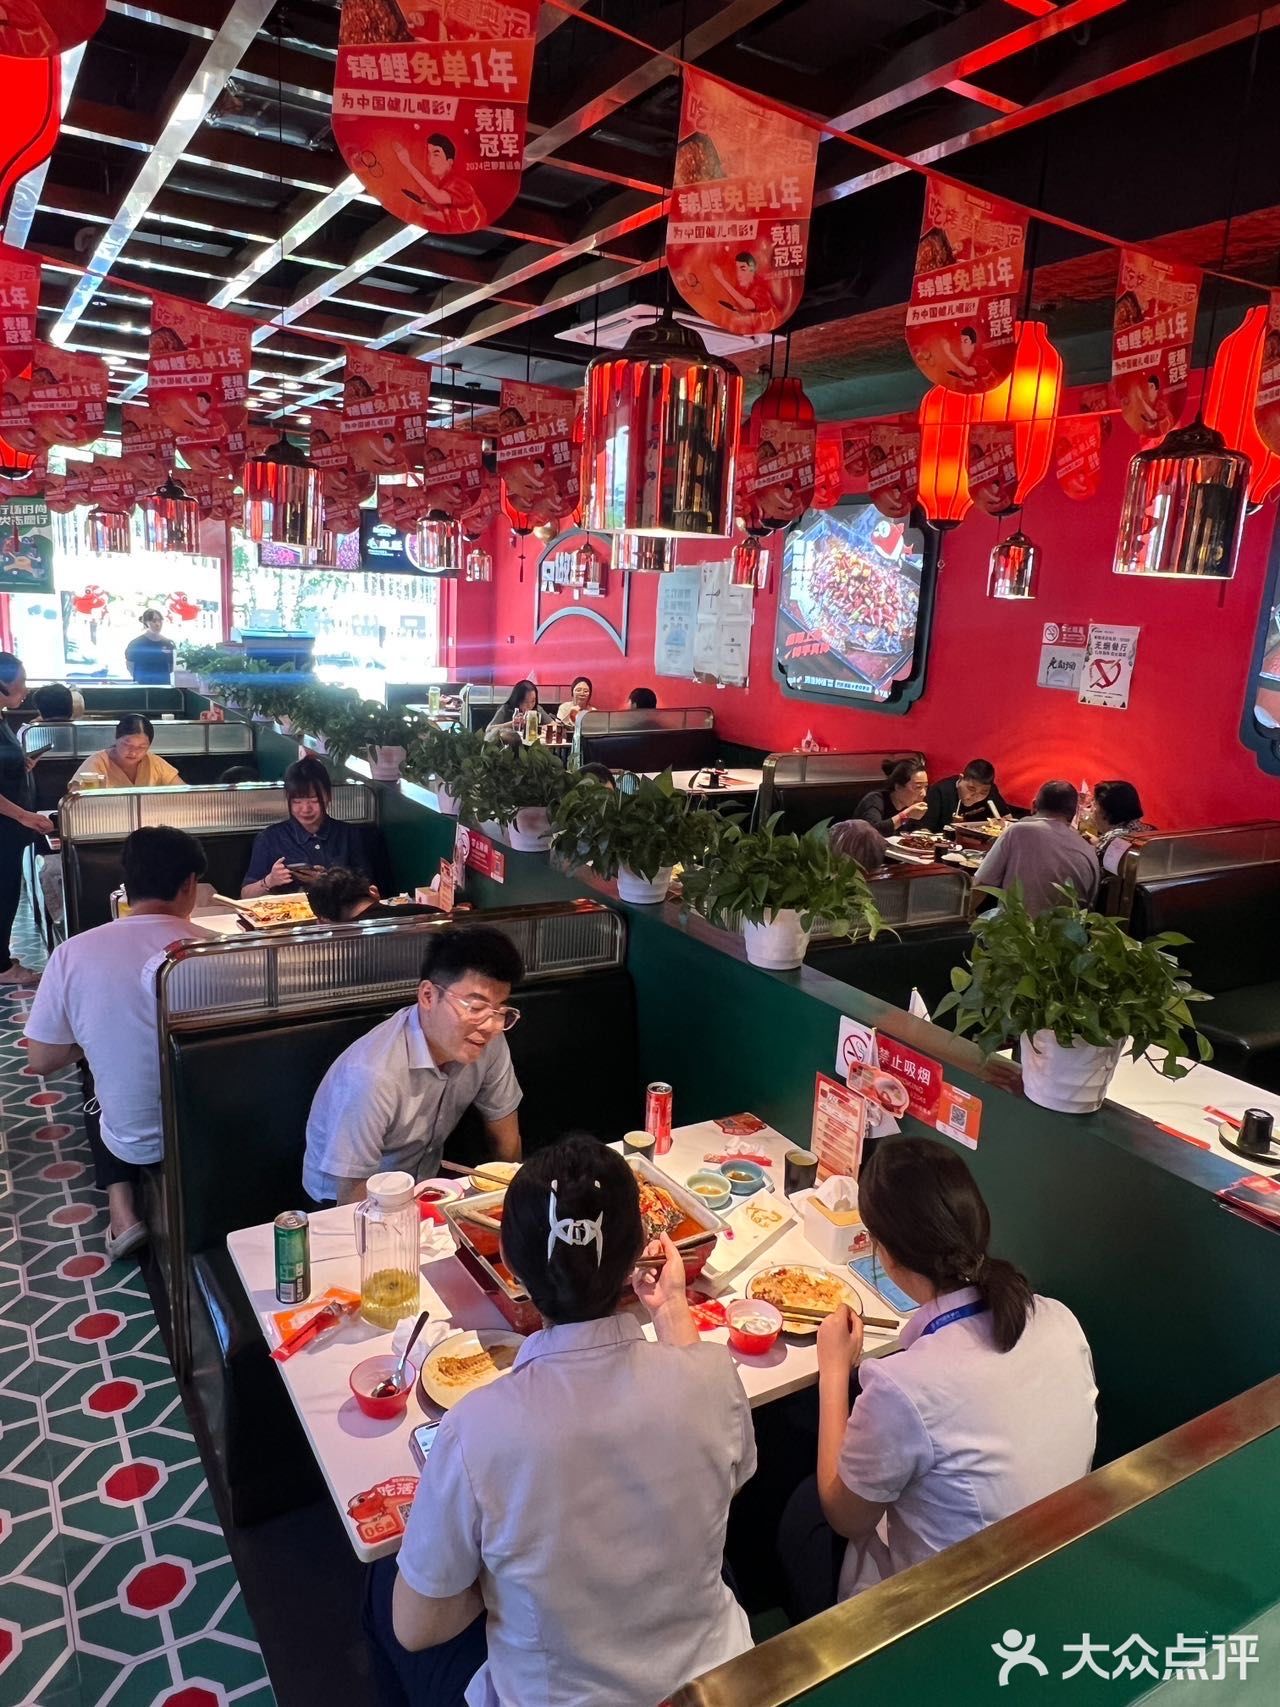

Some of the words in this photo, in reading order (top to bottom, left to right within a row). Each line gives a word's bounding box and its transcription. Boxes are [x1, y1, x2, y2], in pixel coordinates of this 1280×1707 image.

[347, 48, 518, 93] 锦鲤免单1年
[341, 92, 452, 116] 为中国健儿喝彩!
[474, 108, 514, 133] 竞猜
[479, 133, 519, 157] 冠军
[678, 175, 803, 214] 锦鲤免单1年
[673, 222, 755, 240] 为中国健儿喝彩!
[770, 224, 801, 247] 竞猜
[773, 245, 804, 268] 冠军
[917, 255, 1015, 299] 锦鲤免单1年
[987, 298, 1011, 320] 竞猜
[988, 319, 1013, 339] 冠军
[1116, 311, 1188, 353] 锦鲤免单1年
[153, 347, 244, 371] 锦鲤免单1年
[878, 1046, 931, 1086] 禁止吸烟
